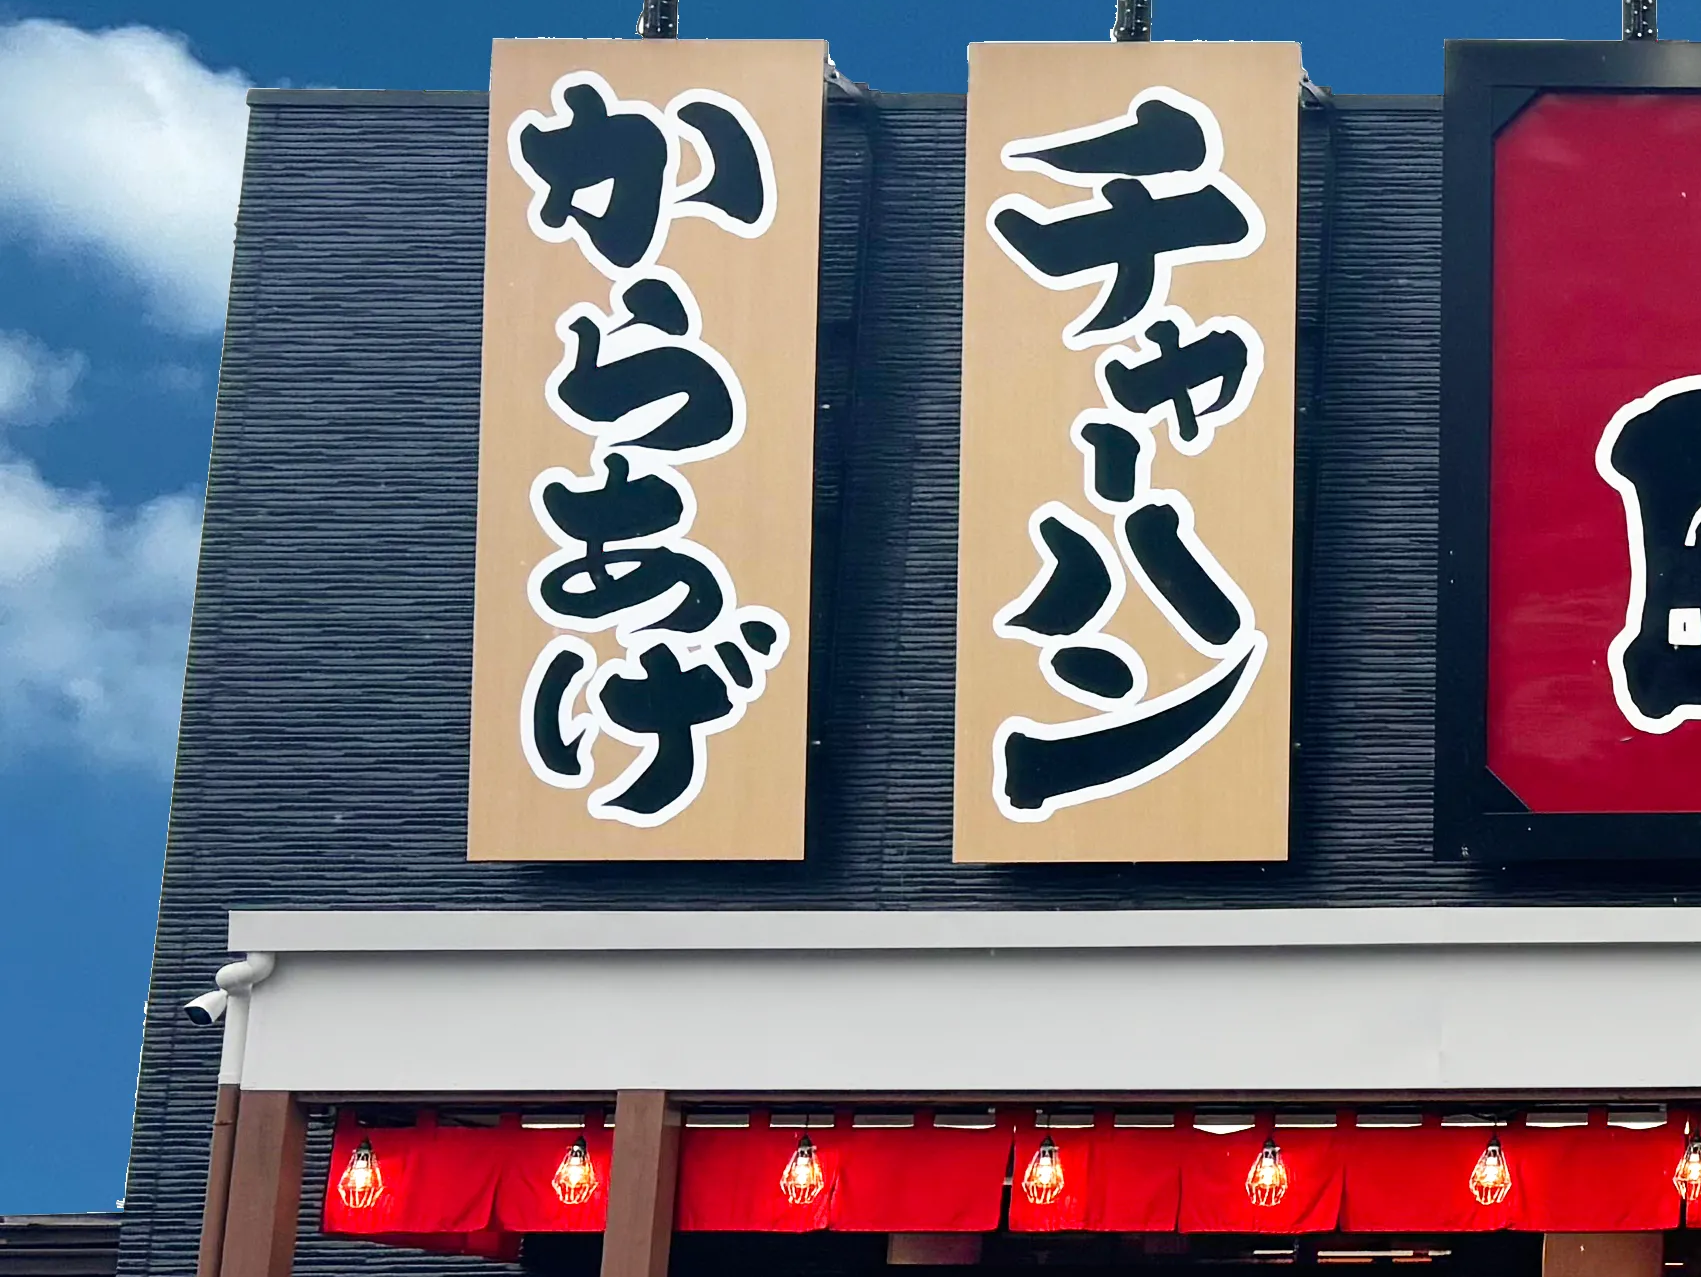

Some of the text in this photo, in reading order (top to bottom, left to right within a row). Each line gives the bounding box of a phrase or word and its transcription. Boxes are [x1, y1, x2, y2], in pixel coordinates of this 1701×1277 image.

[508, 70, 788, 827] からあげ
[986, 86, 1269, 822] チャーハン
